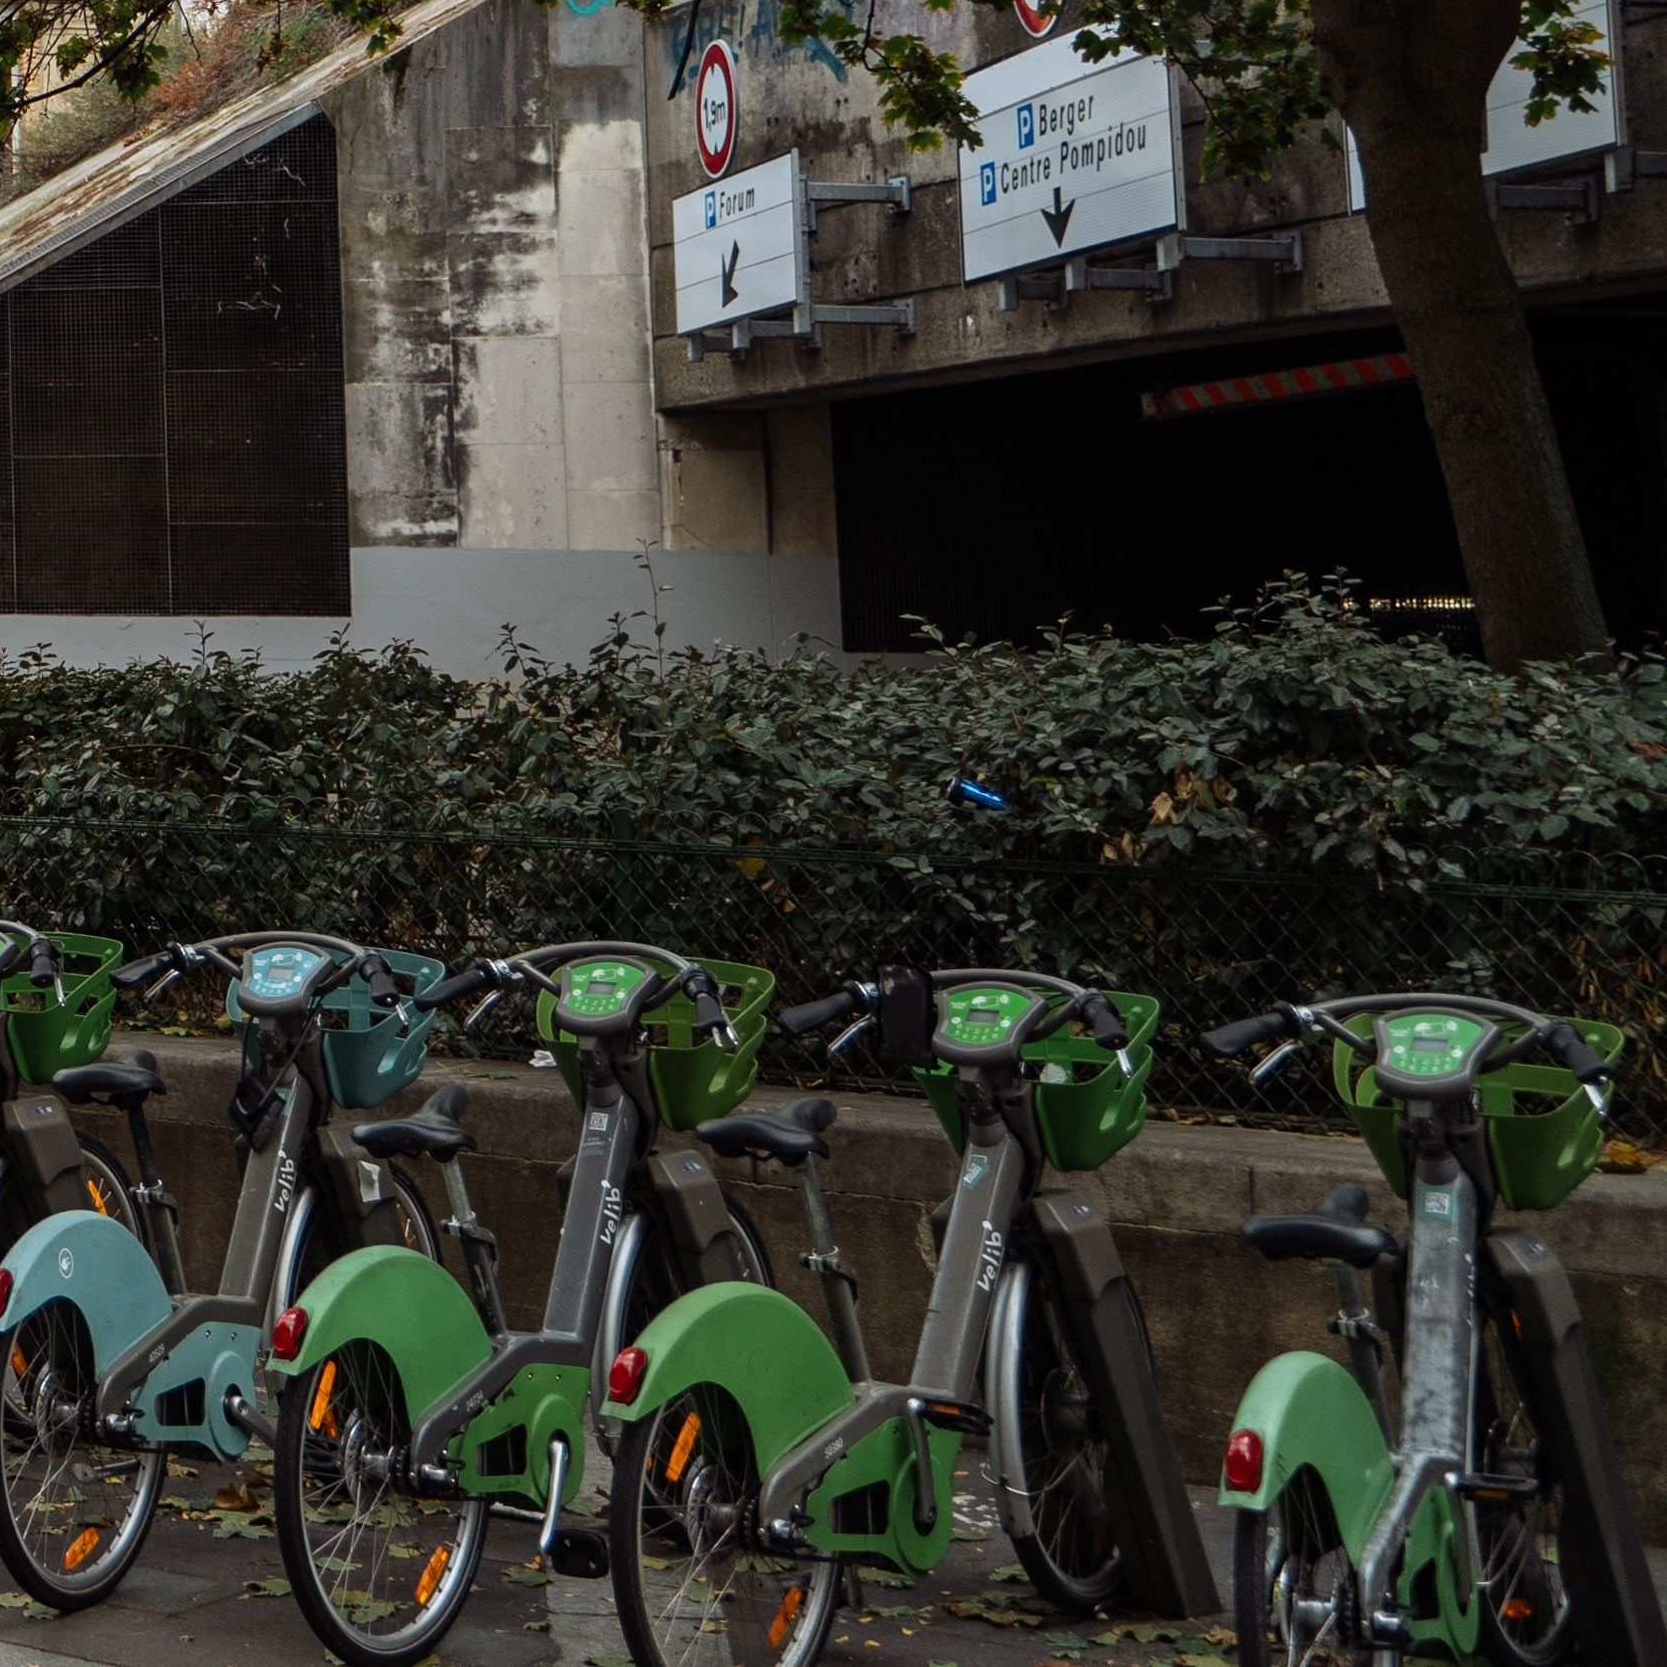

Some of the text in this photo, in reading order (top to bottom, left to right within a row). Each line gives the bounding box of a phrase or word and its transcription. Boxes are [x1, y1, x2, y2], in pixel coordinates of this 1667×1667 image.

[703, 100, 726, 132] 1,9m
[1039, 95, 1094, 136] Berger
[1001, 155, 1051, 194] Centre
[1060, 122, 1147, 175] Pompidou
[719, 186, 755, 219] Forum
